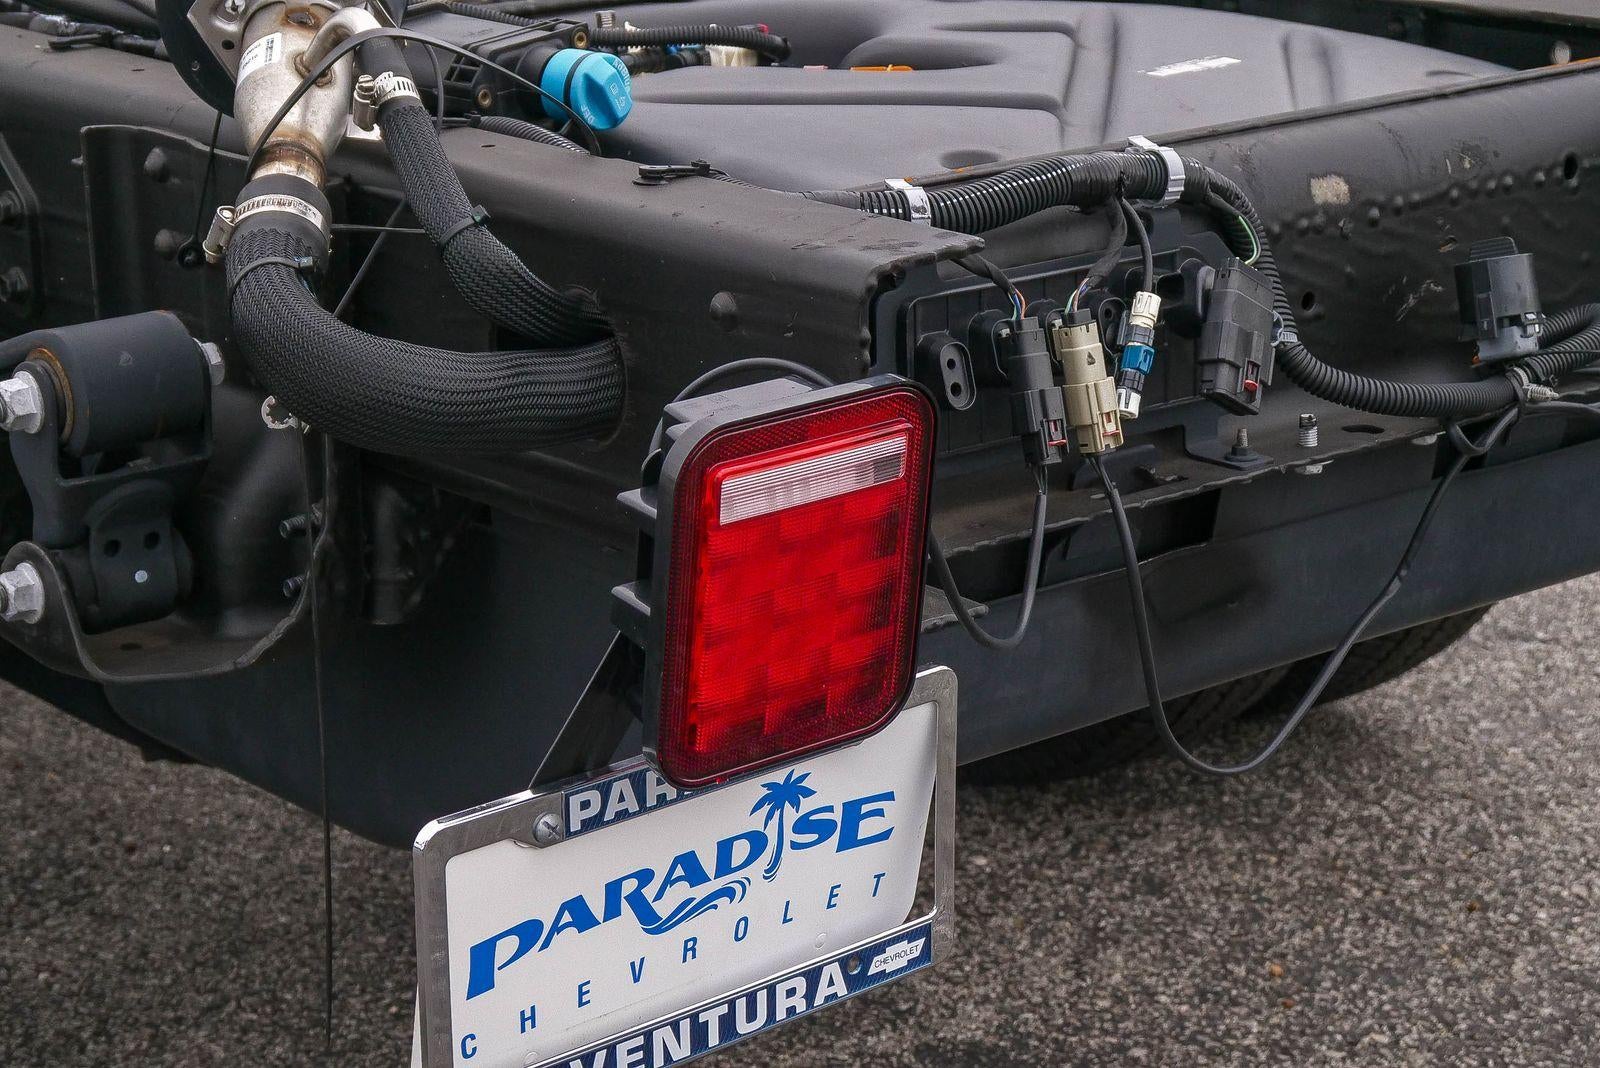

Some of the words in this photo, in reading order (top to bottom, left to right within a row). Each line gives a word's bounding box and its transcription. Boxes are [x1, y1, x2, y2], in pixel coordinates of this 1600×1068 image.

[569, 771, 693, 833] PAR
[465, 769, 896, 1000] PARADISE
[460, 872, 886, 1059] CHEVROLET
[874, 944, 919, 968] CHEVROLET
